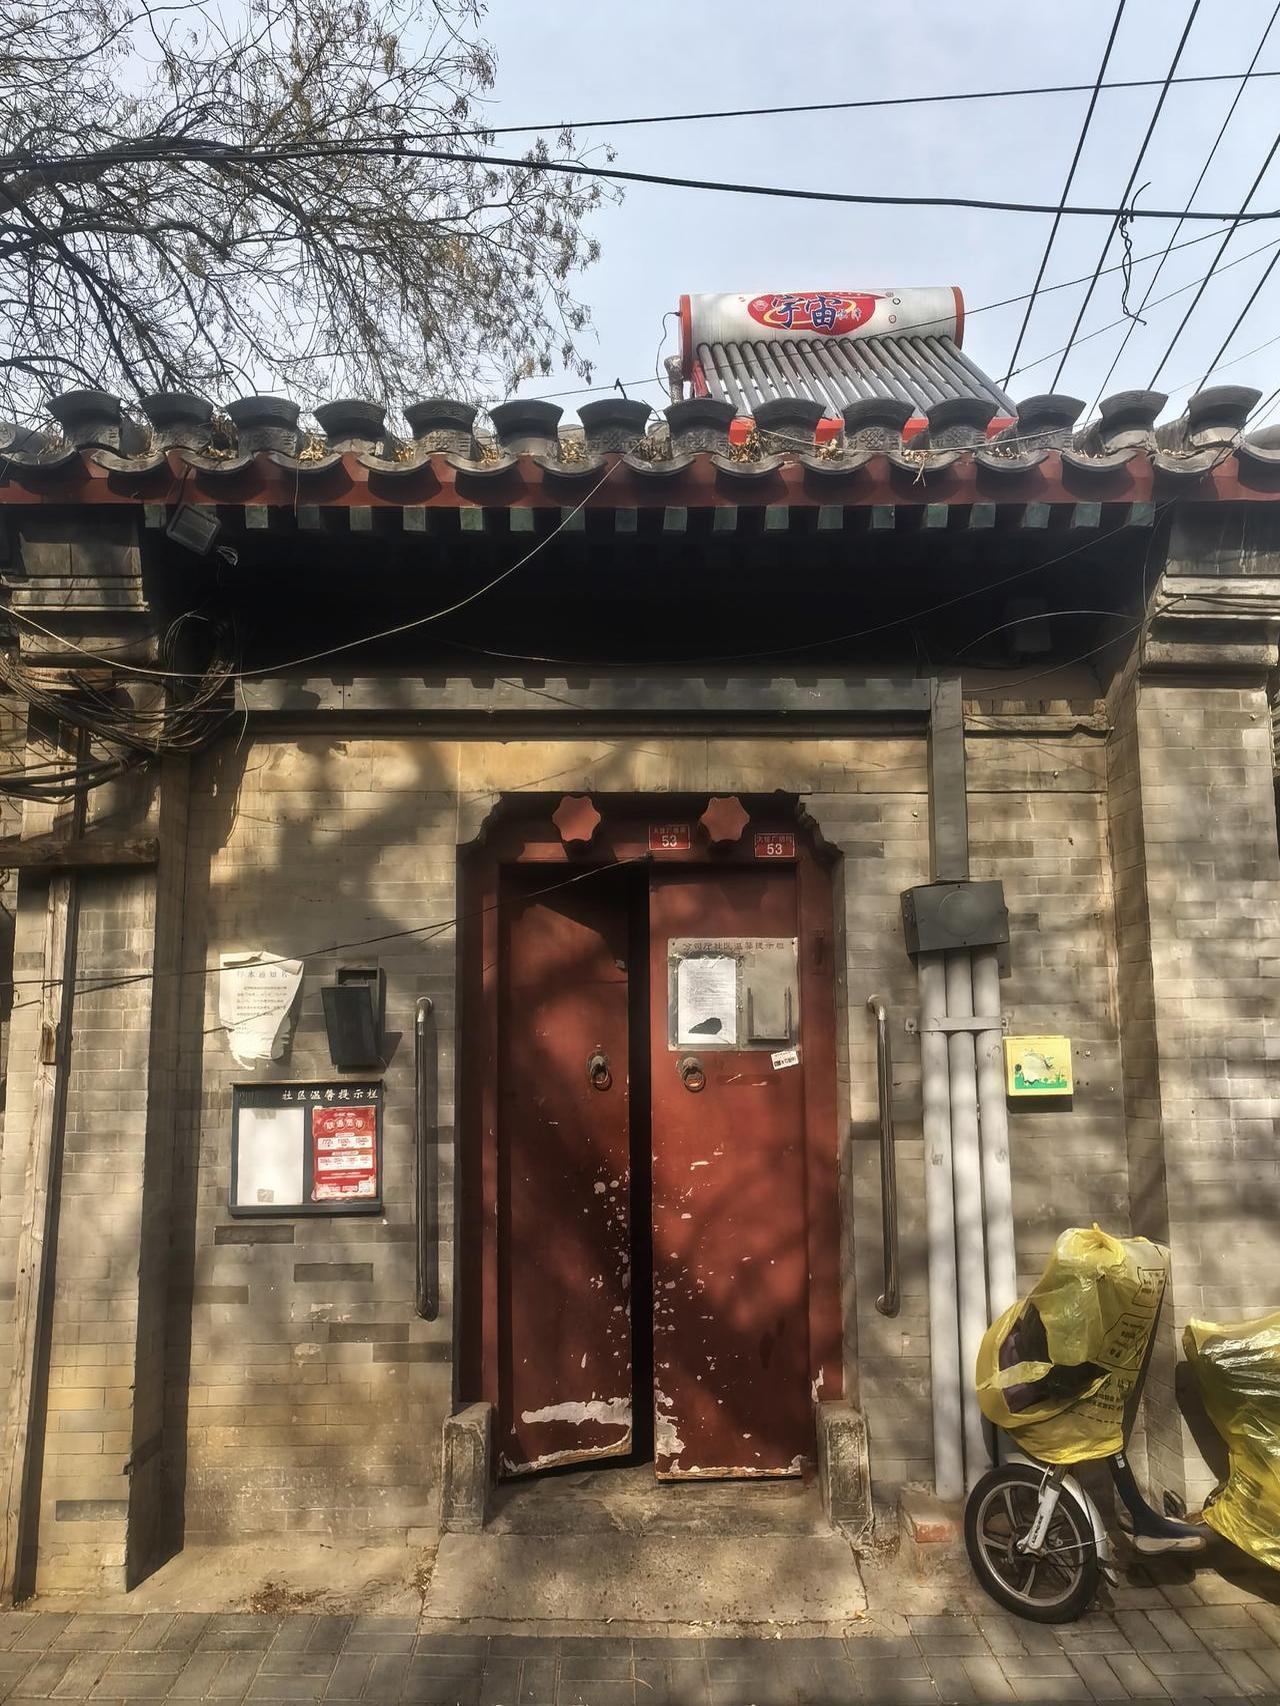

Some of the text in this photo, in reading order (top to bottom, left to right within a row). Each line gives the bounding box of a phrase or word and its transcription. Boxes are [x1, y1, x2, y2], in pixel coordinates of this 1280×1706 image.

[662, 834, 677, 847] 53
[767, 843, 782, 855] 53
[282, 1089, 379, 1101] 社区温馨提示栏
